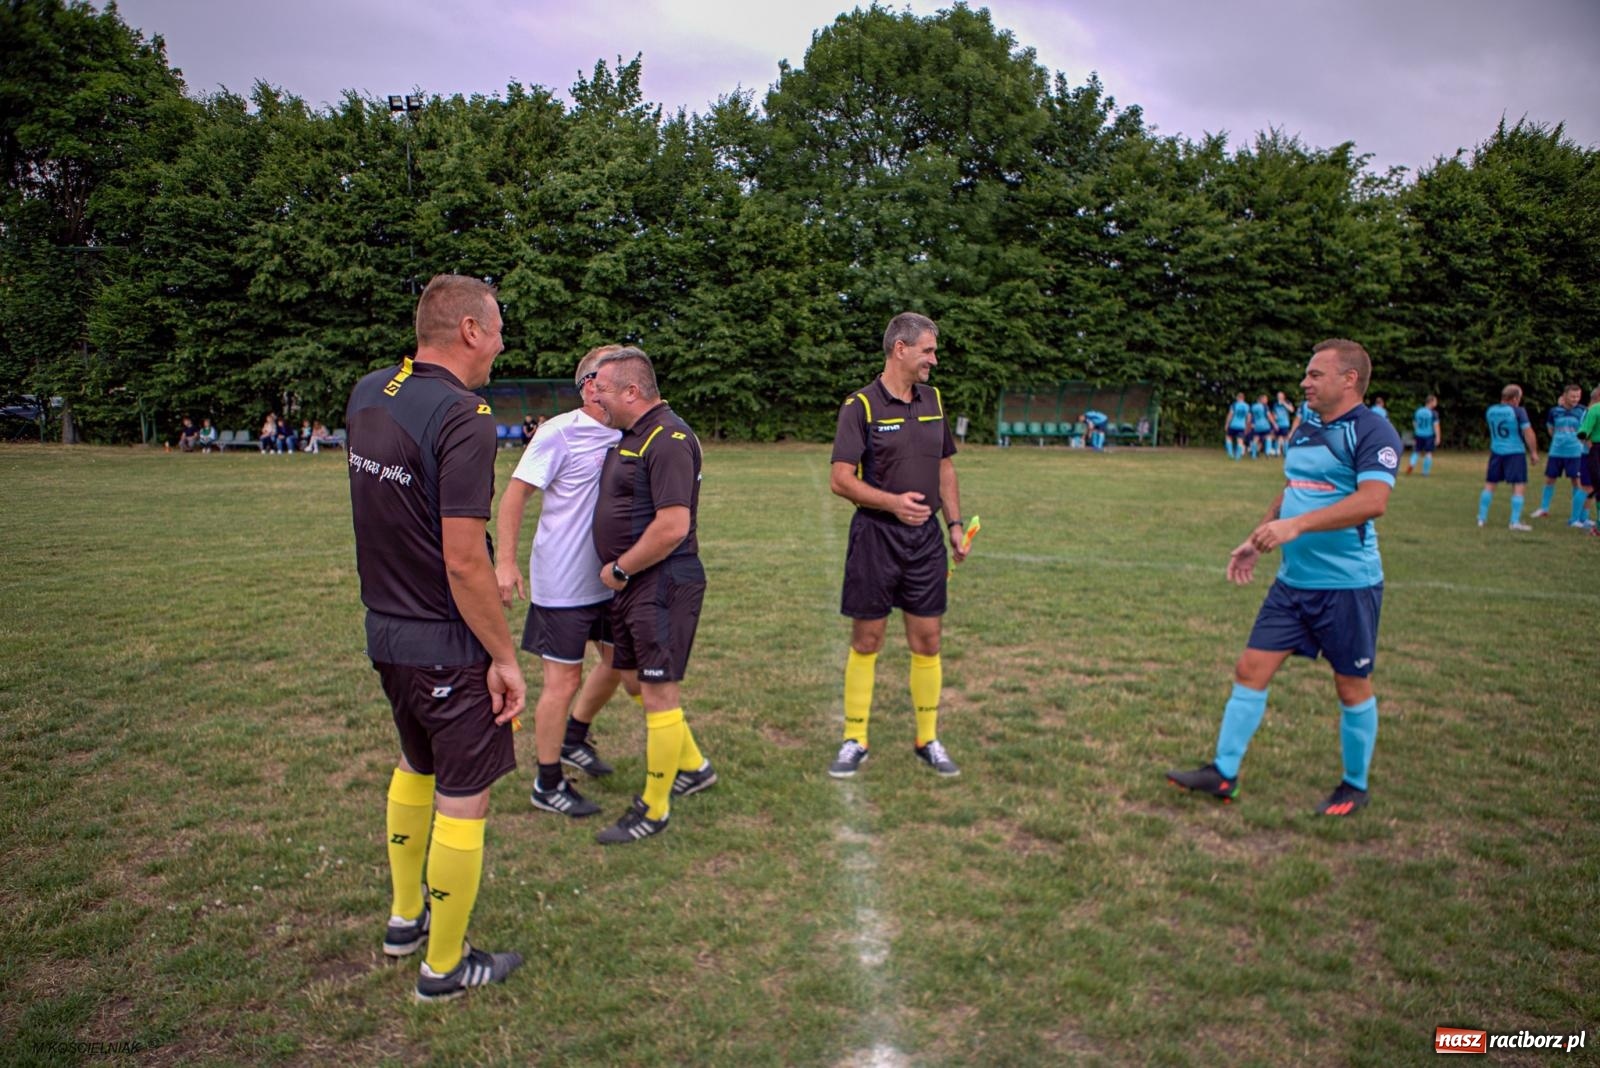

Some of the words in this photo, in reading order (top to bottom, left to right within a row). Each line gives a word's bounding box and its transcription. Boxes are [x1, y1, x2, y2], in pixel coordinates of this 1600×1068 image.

[1491, 420, 1510, 440] 16
[362, 458, 381, 475] nas
[379, 465, 412, 487] piłka
